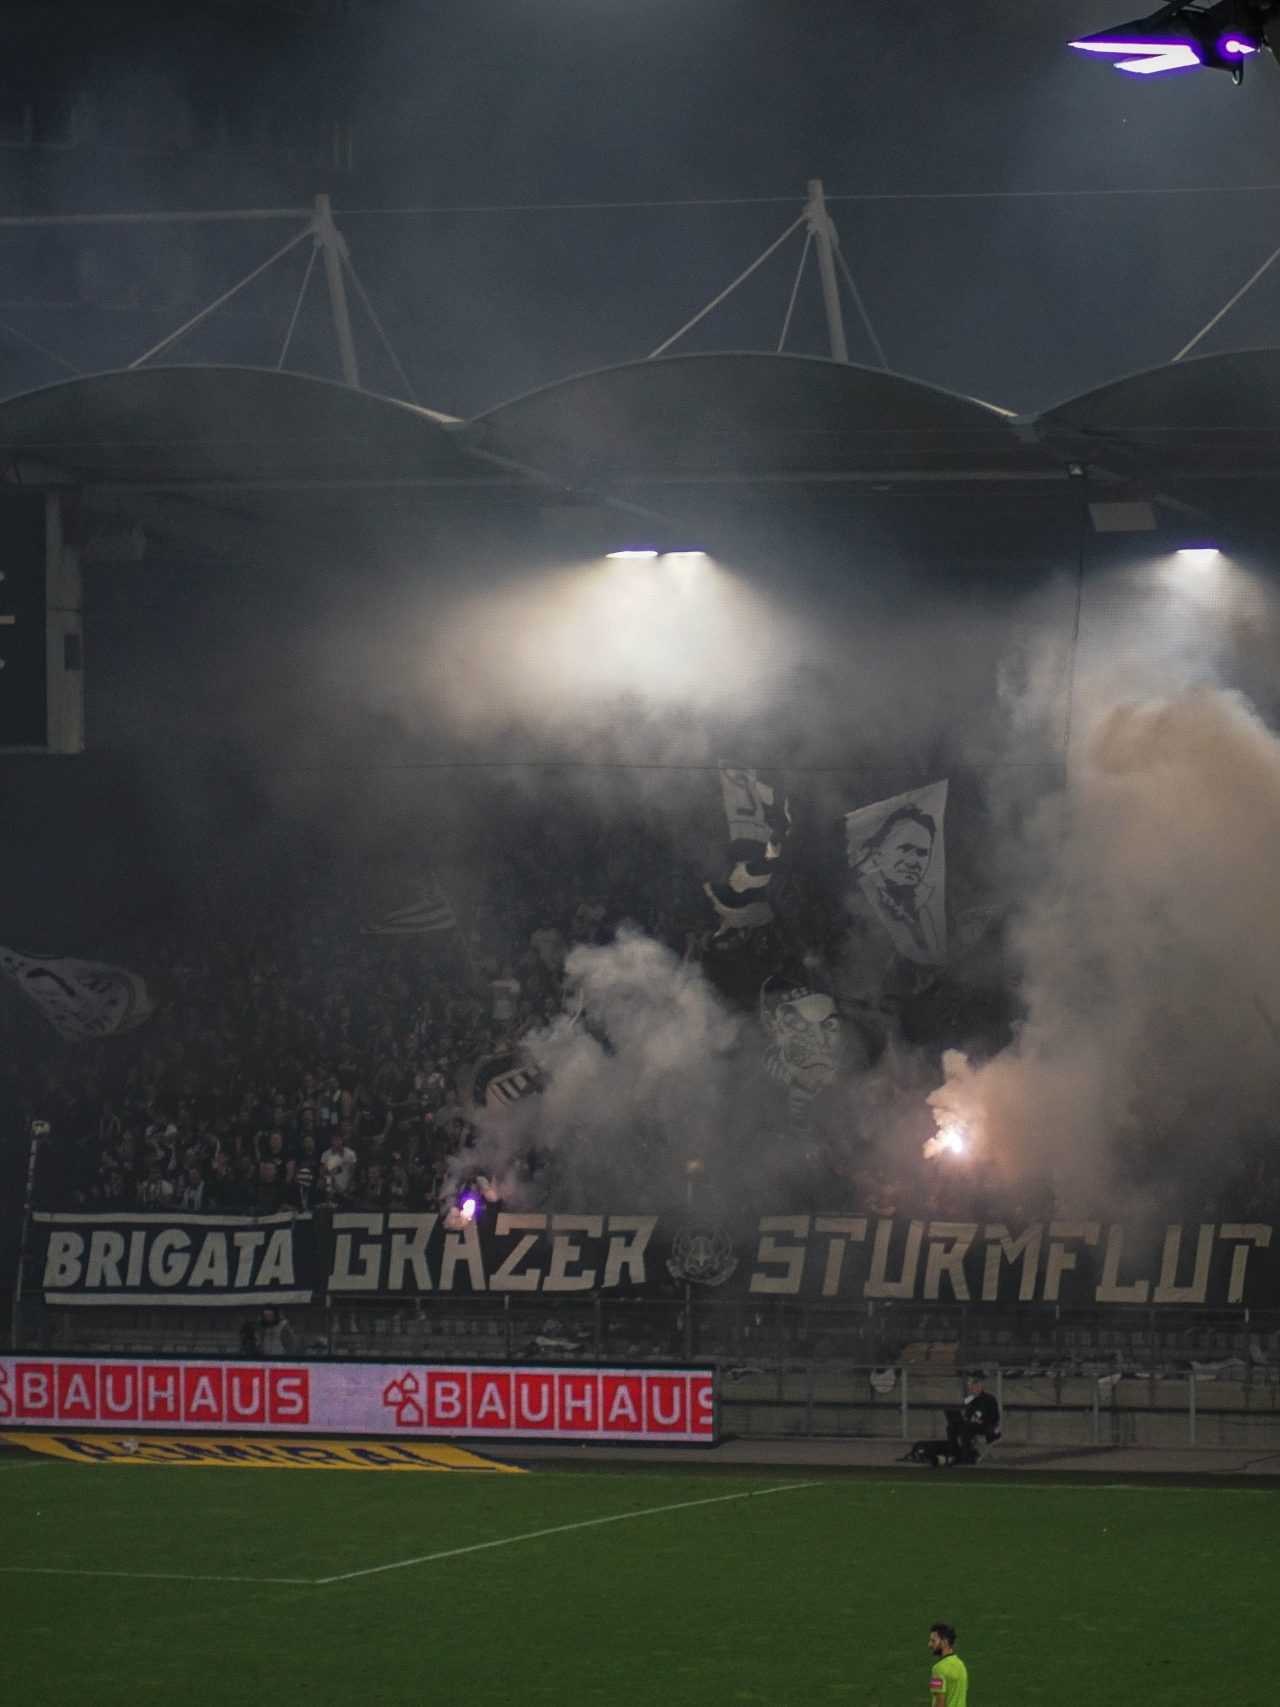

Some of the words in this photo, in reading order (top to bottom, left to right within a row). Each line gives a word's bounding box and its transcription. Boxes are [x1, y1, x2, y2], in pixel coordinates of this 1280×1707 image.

[42, 1228, 297, 1288] BRIGATA
[328, 1212, 659, 1292] GRAZER
[749, 1215, 1273, 1304] STURMFLUT
[22, 1372, 304, 1416] BAUHAUS
[50, 1436, 497, 1470] ADMIRAL
